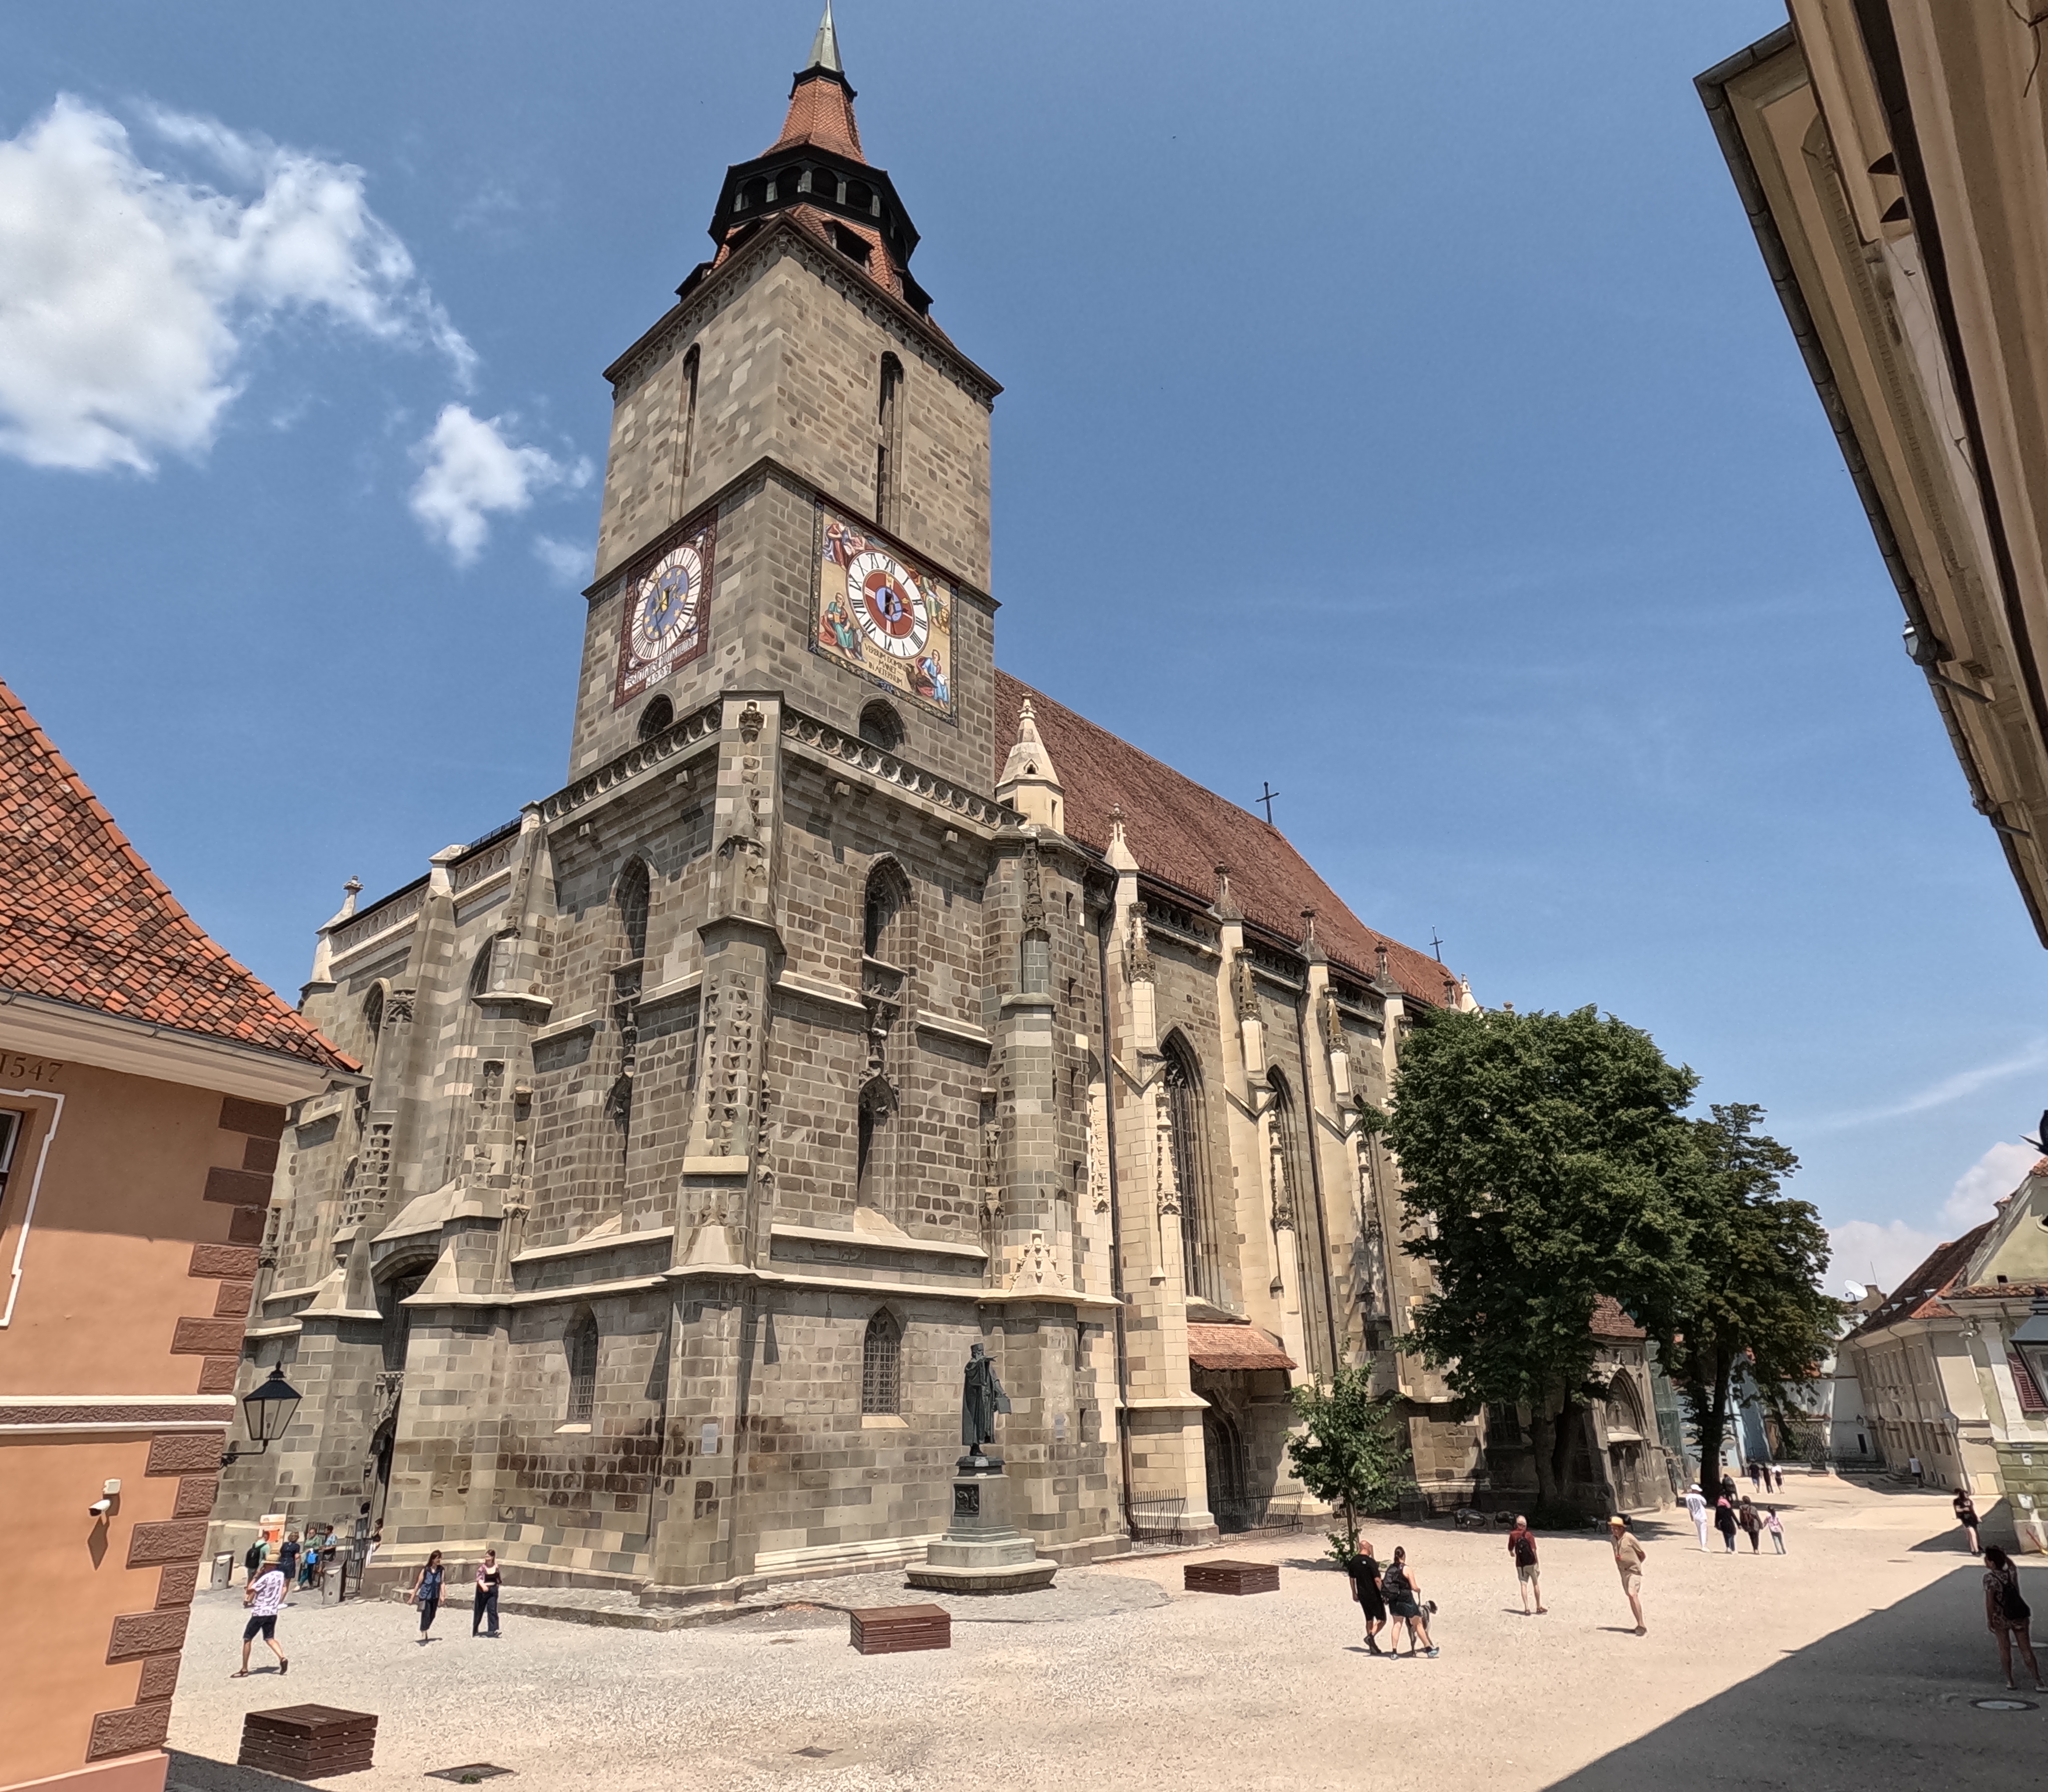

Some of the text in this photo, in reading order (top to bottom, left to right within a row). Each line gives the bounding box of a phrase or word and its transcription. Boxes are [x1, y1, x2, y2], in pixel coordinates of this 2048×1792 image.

[853, 558, 868, 576] X
[866, 553, 879, 569] XI
[883, 555, 896, 575] XII
[849, 574, 862, 591] IX
[902, 576, 910, 585] I
[851, 598, 867, 619] VIII
[863, 618, 877, 640] VII
[915, 616, 927, 631] III
[884, 635, 895, 655] VI
[902, 640, 911, 656] V
[910, 631, 924, 650] IIII
[864, 643, 886, 661] VERBUM
[868, 661, 875, 670] IN
[878, 659, 896, 674] MANET
[0, 1053, 64, 1083] 1547
